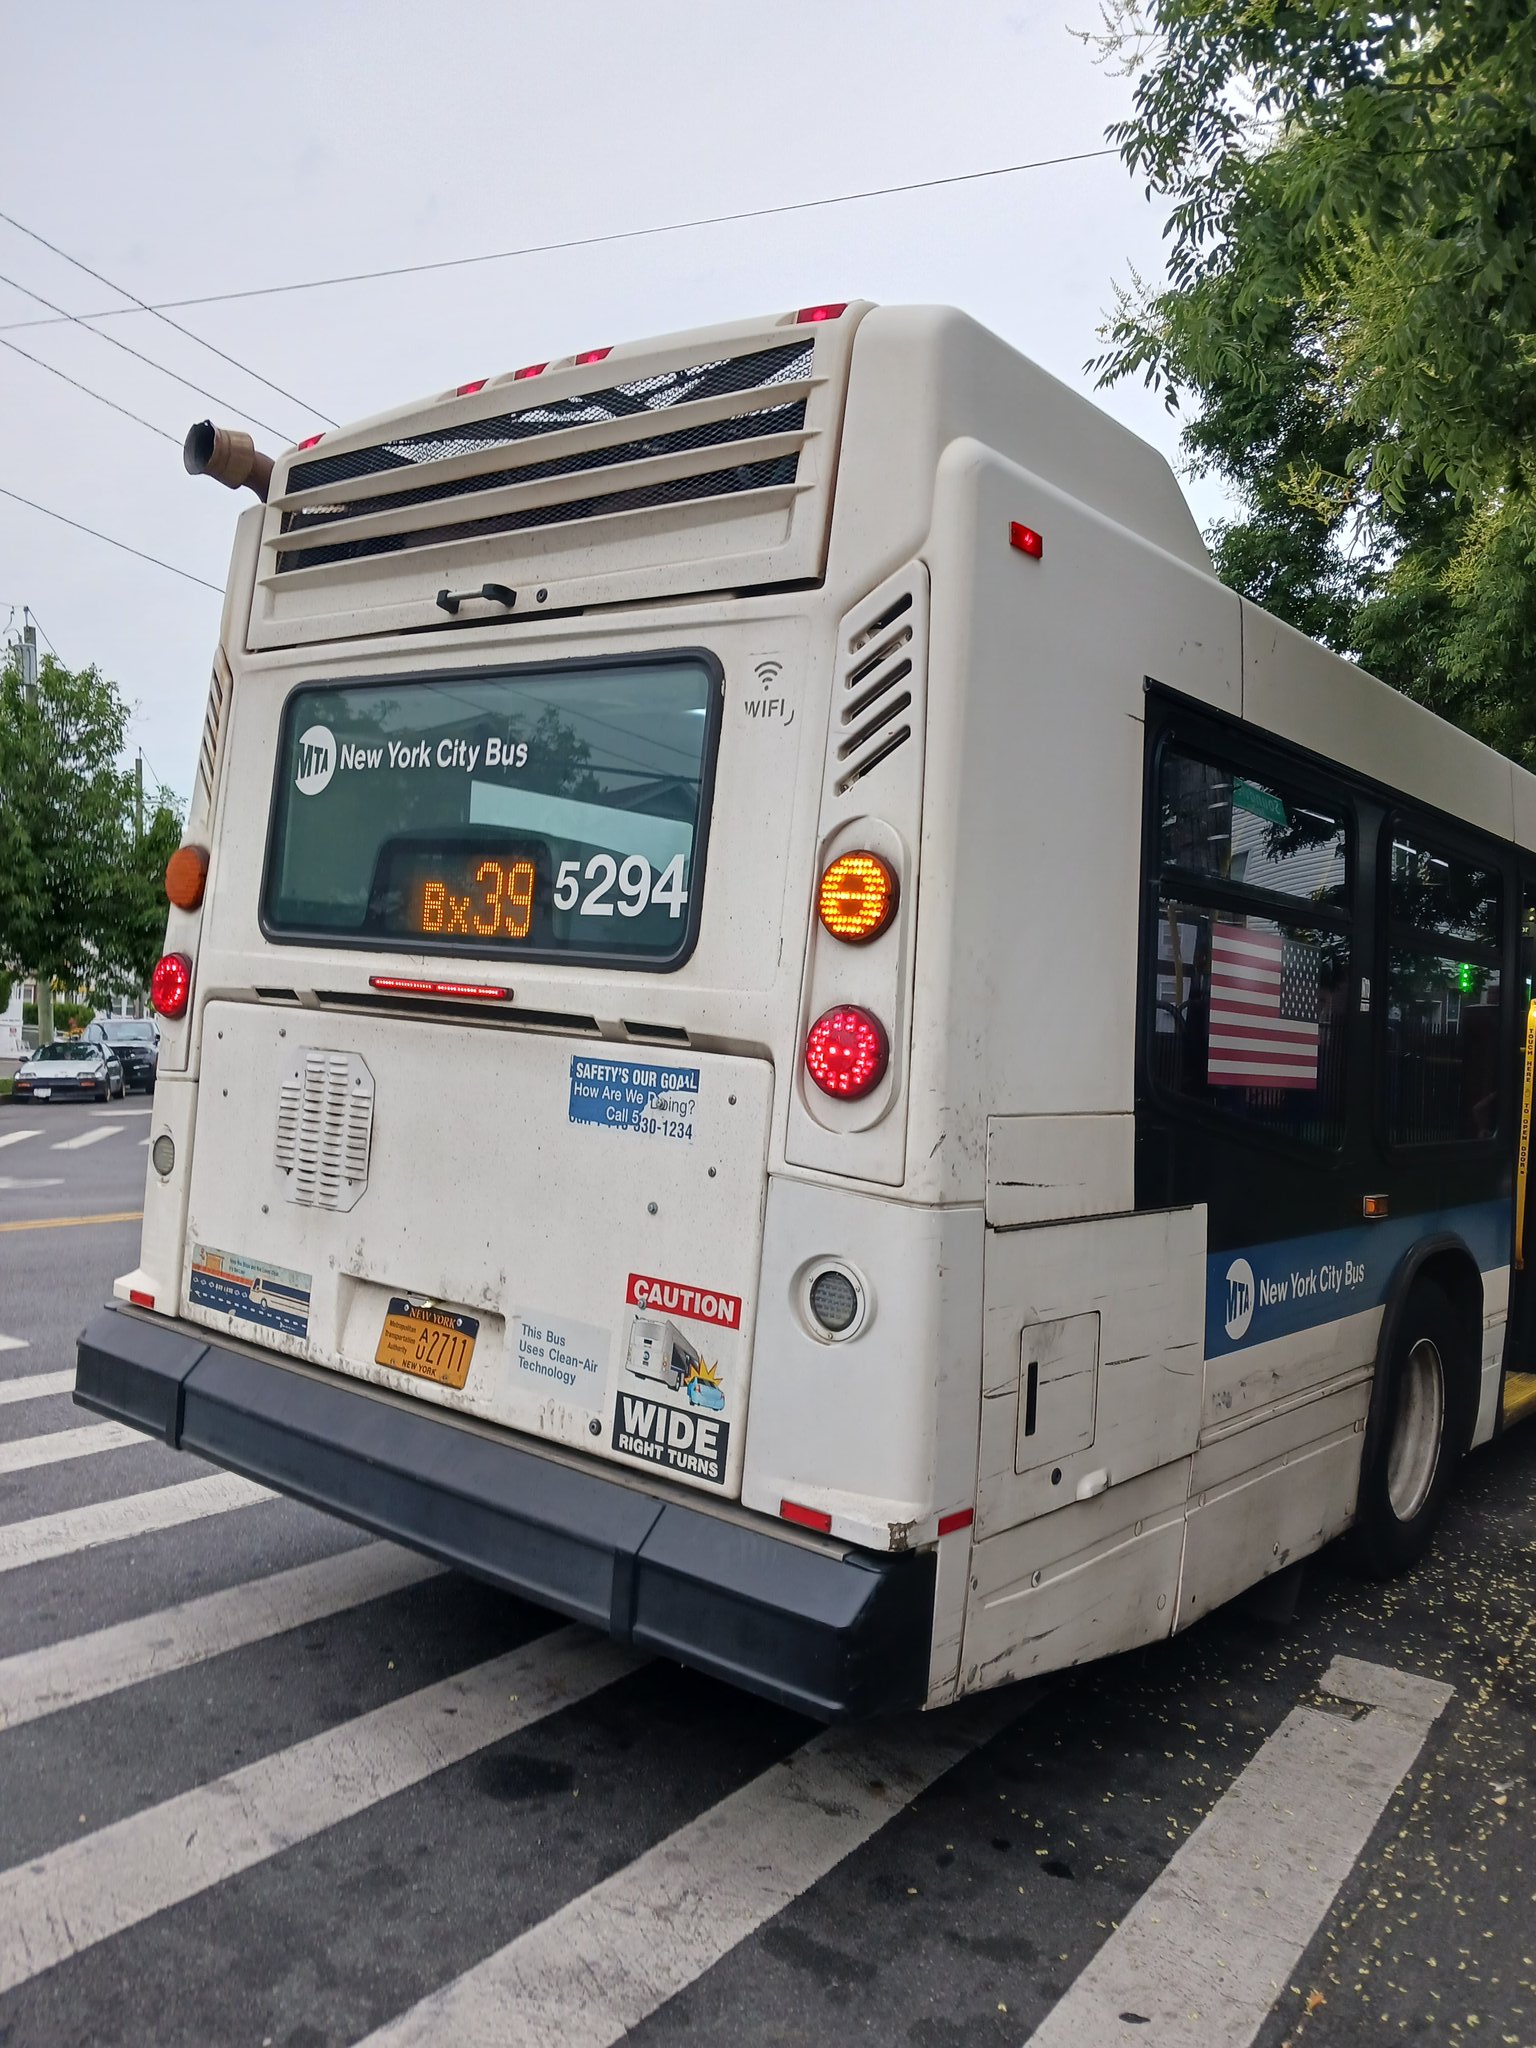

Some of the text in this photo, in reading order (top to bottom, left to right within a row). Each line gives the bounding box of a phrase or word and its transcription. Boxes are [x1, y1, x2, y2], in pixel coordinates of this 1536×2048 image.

[744, 698, 785, 718] WIFI
[340, 737, 528, 773] New York City Bus
[553, 853, 688, 918] 5294
[422, 862, 534, 937] Bx39
[576, 1062, 629, 1084] SAFETY'S
[632, 1069, 657, 1088] OUR
[574, 1082, 600, 1098] How
[602, 1085, 622, 1101] Are
[625, 1089, 644, 1104] We
[606, 1106, 628, 1123] Call
[1259, 1260, 1365, 1306] New York City Bus
[634, 1279, 735, 1323] CAUTION
[389, 1320, 417, 1333] Metropolitan
[409, 1307, 457, 1329] NEW YORK
[385, 1329, 416, 1344] Transportation
[521, 1323, 566, 1347] This Bus
[387, 1342, 407, 1355] Authority
[519, 1339, 598, 1373] Uses Clean-Air
[401, 1359, 437, 1377] NEW YORK
[518, 1355, 576, 1386] Technology
[623, 1396, 720, 1460] WIDE
[619, 1433, 718, 1478] RIGHT TURNS
